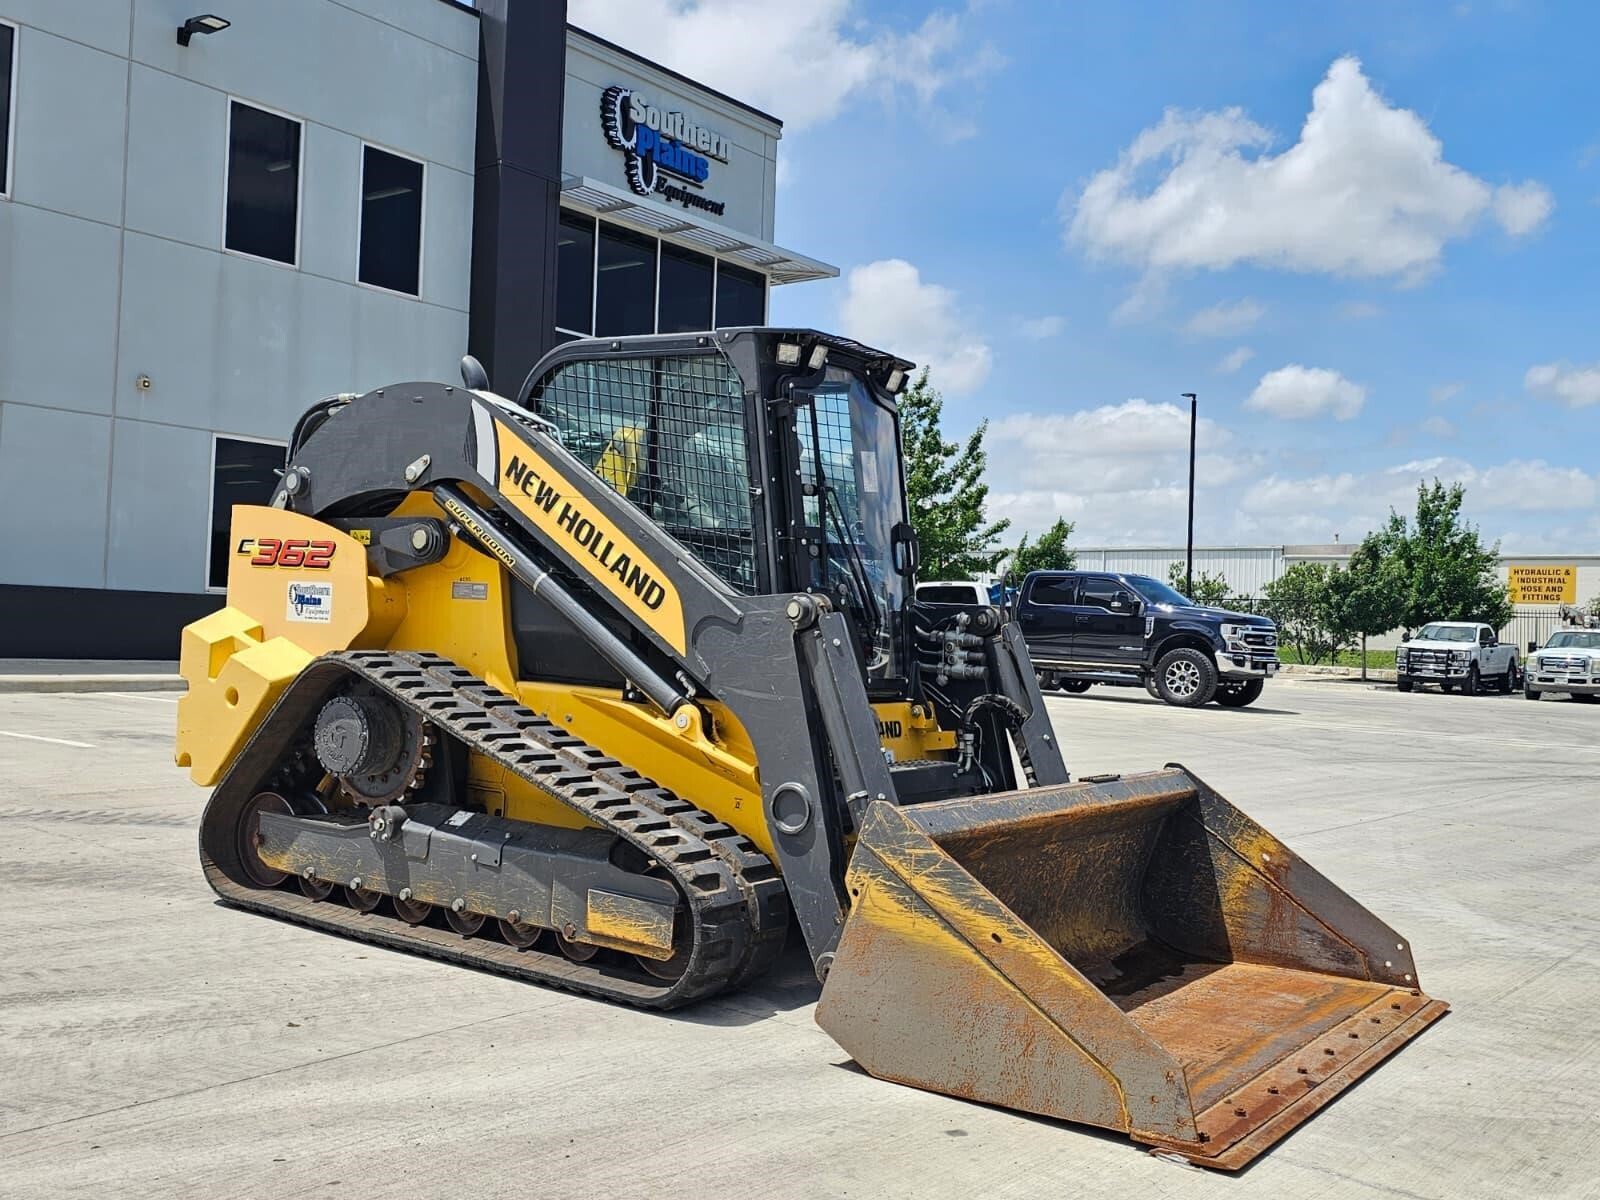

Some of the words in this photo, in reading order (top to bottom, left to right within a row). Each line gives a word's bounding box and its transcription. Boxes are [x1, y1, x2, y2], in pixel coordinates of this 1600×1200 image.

[630, 91, 733, 162] Southern
[635, 123, 709, 182] Plains
[656, 175, 725, 215] Equipment
[505, 455, 560, 513] NEW
[556, 502, 666, 610] HOLLAND
